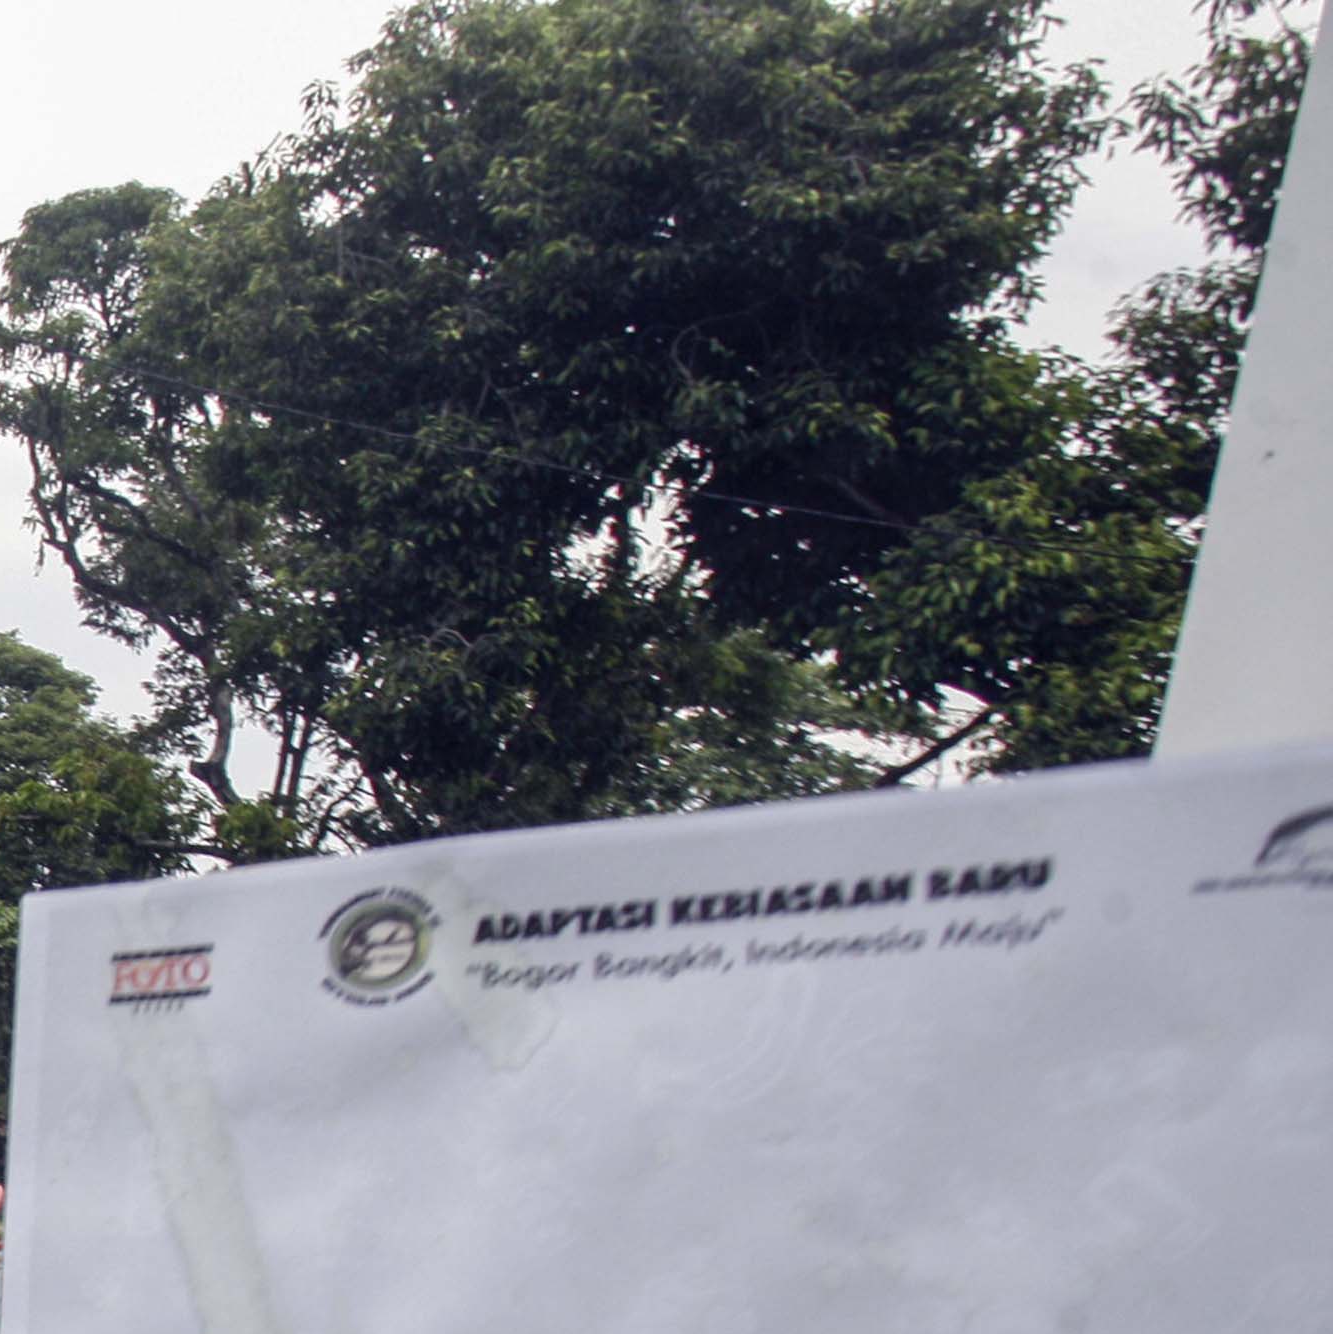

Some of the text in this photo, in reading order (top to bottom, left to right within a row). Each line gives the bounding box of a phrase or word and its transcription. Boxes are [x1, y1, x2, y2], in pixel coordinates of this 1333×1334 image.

[472, 854, 1055, 947] ADAPTASI KEBIASAAN BARU
[745, 925, 927, 965] Indonesia
